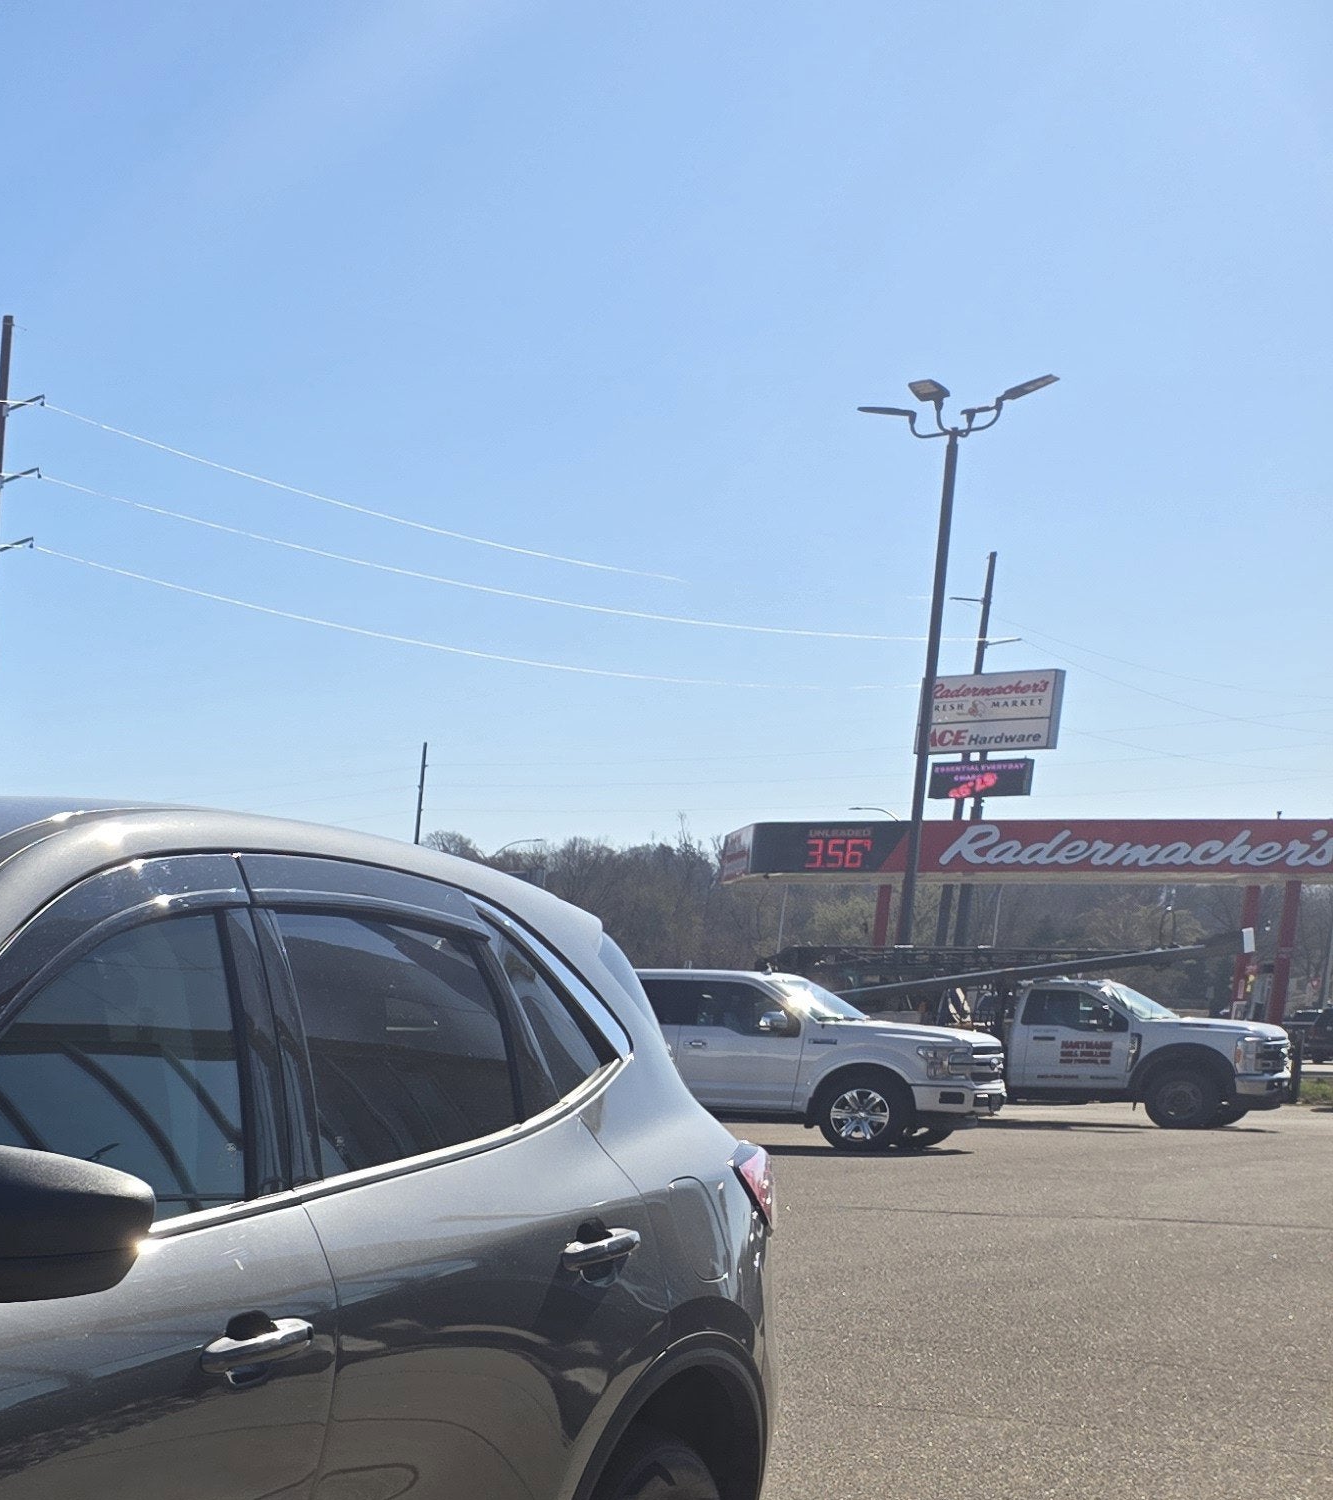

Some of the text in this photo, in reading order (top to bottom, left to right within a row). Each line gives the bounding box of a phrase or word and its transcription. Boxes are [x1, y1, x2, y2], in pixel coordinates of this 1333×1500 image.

[934, 698, 1043, 712] RESH MARKET
[968, 732, 1041, 746] Hardware
[809, 829, 871, 838] UNLEADED
[939, 824, 1333, 866] Radermacher's
